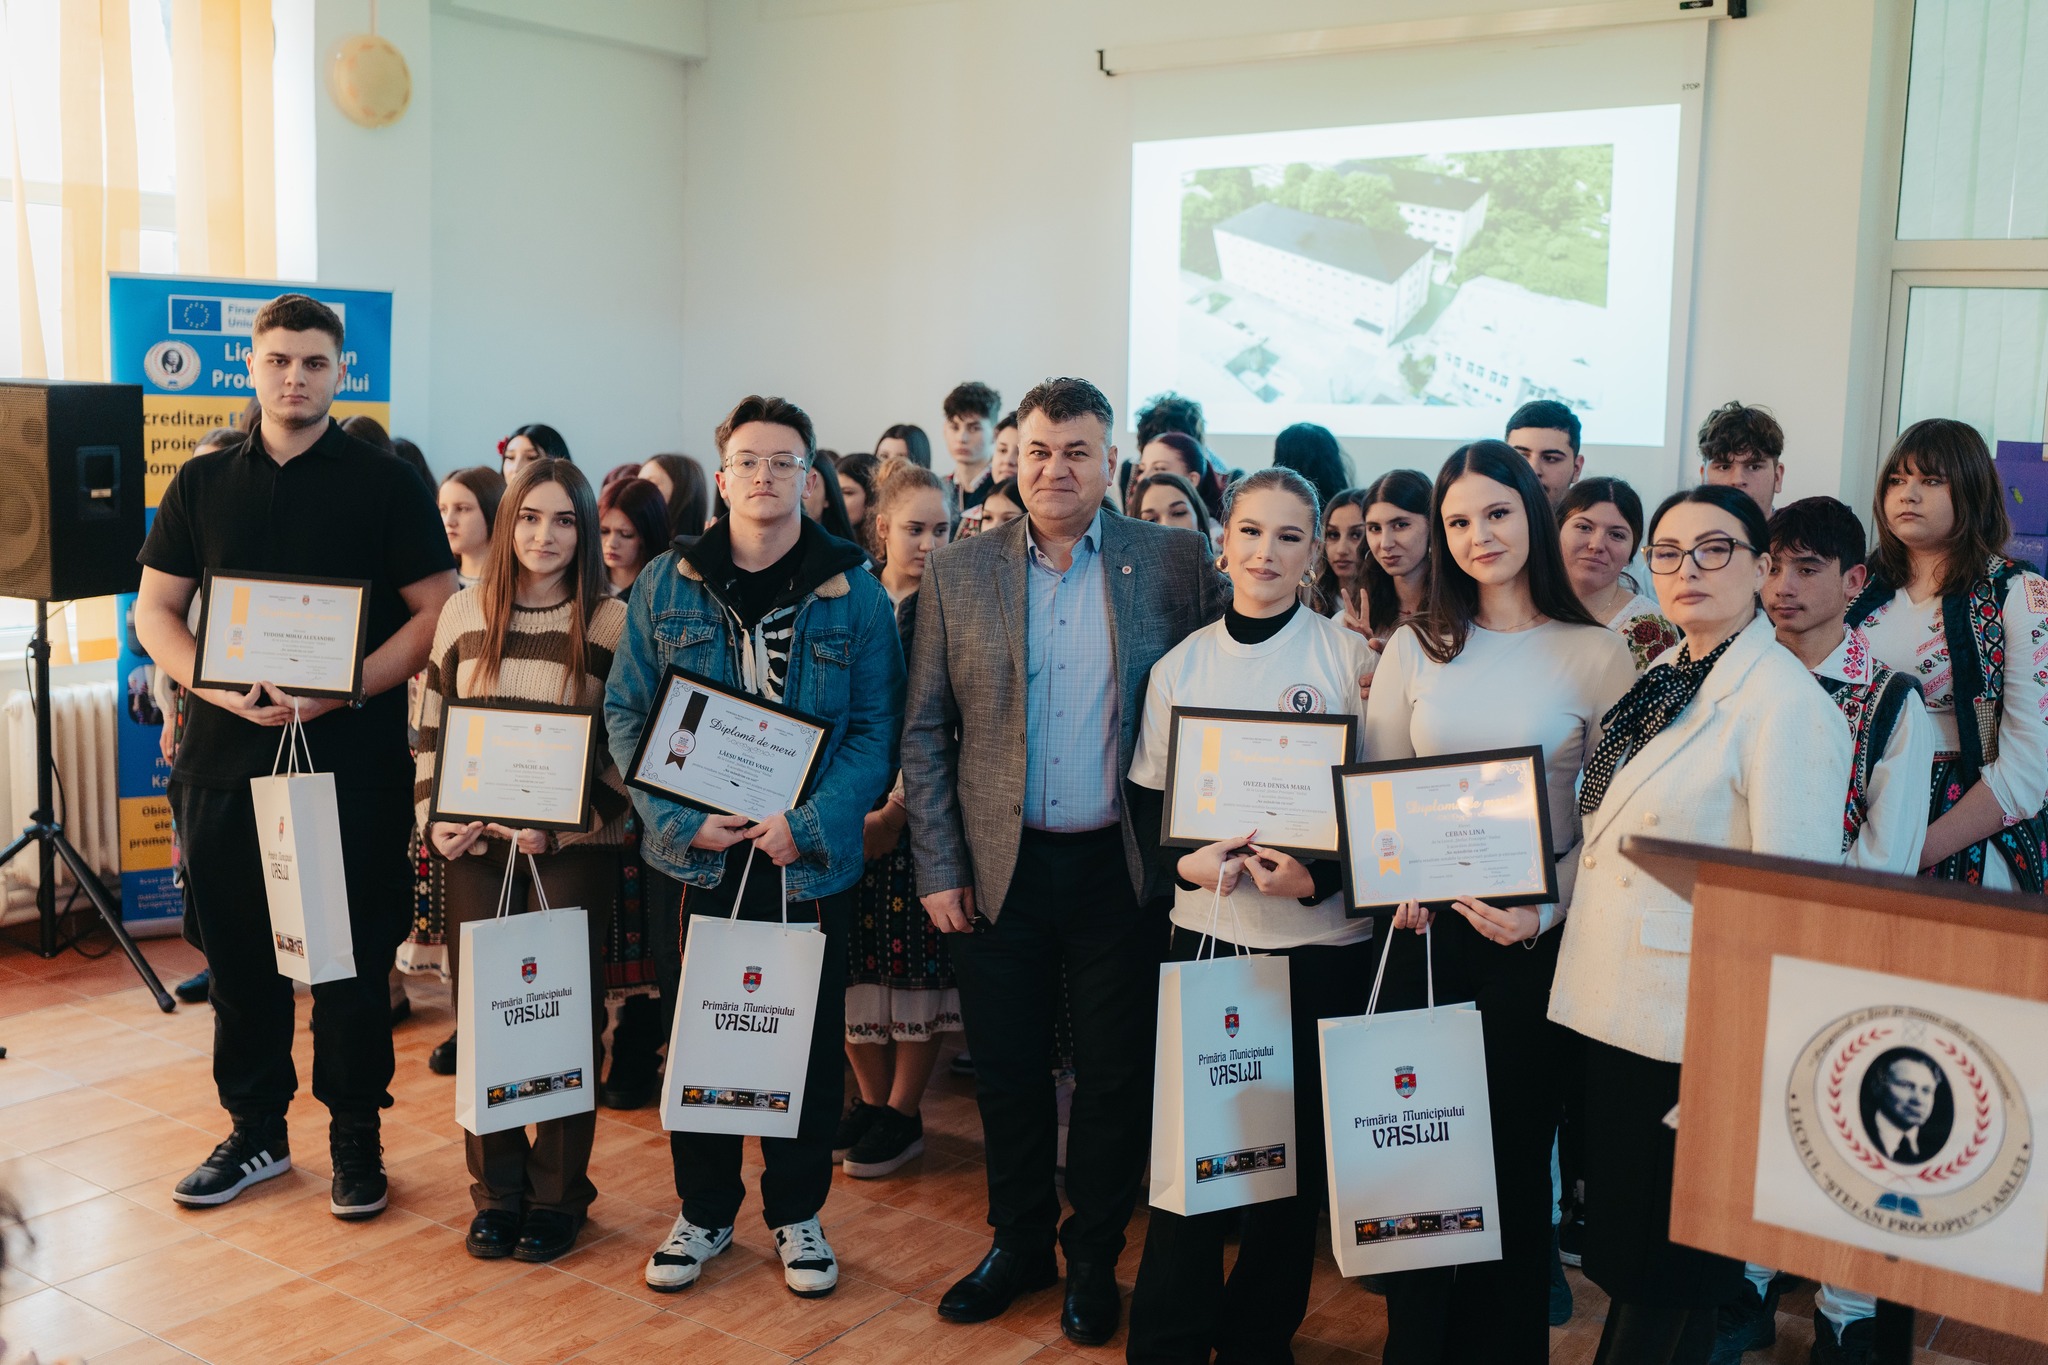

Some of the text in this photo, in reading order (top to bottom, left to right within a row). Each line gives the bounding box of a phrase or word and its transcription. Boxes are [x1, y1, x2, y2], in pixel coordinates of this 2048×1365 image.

[144, 411, 223, 426] creditare
[152, 435, 197, 453] proie
[756, 737, 770, 748] de
[770, 745, 797, 758] merit
[737, 756, 755, 767] MATEI
[755, 762, 774, 773] VASILE
[1291, 784, 1311, 792] MARIA
[1469, 828, 1486, 836] LINA
[526, 987, 572, 1003] Municipiului
[504, 1000, 559, 1026] VASLUI
[743, 1002, 795, 1016] Municipiului
[715, 1013, 779, 1033] VASLUI
[1229, 1046, 1274, 1060] Municipiului
[1209, 1060, 1262, 1086] VASLUI
[1402, 1106, 1465, 1121] Municipiului
[1372, 1121, 1449, 1148] VASLUI
[1981, 1156, 2028, 1214] VASLUI
